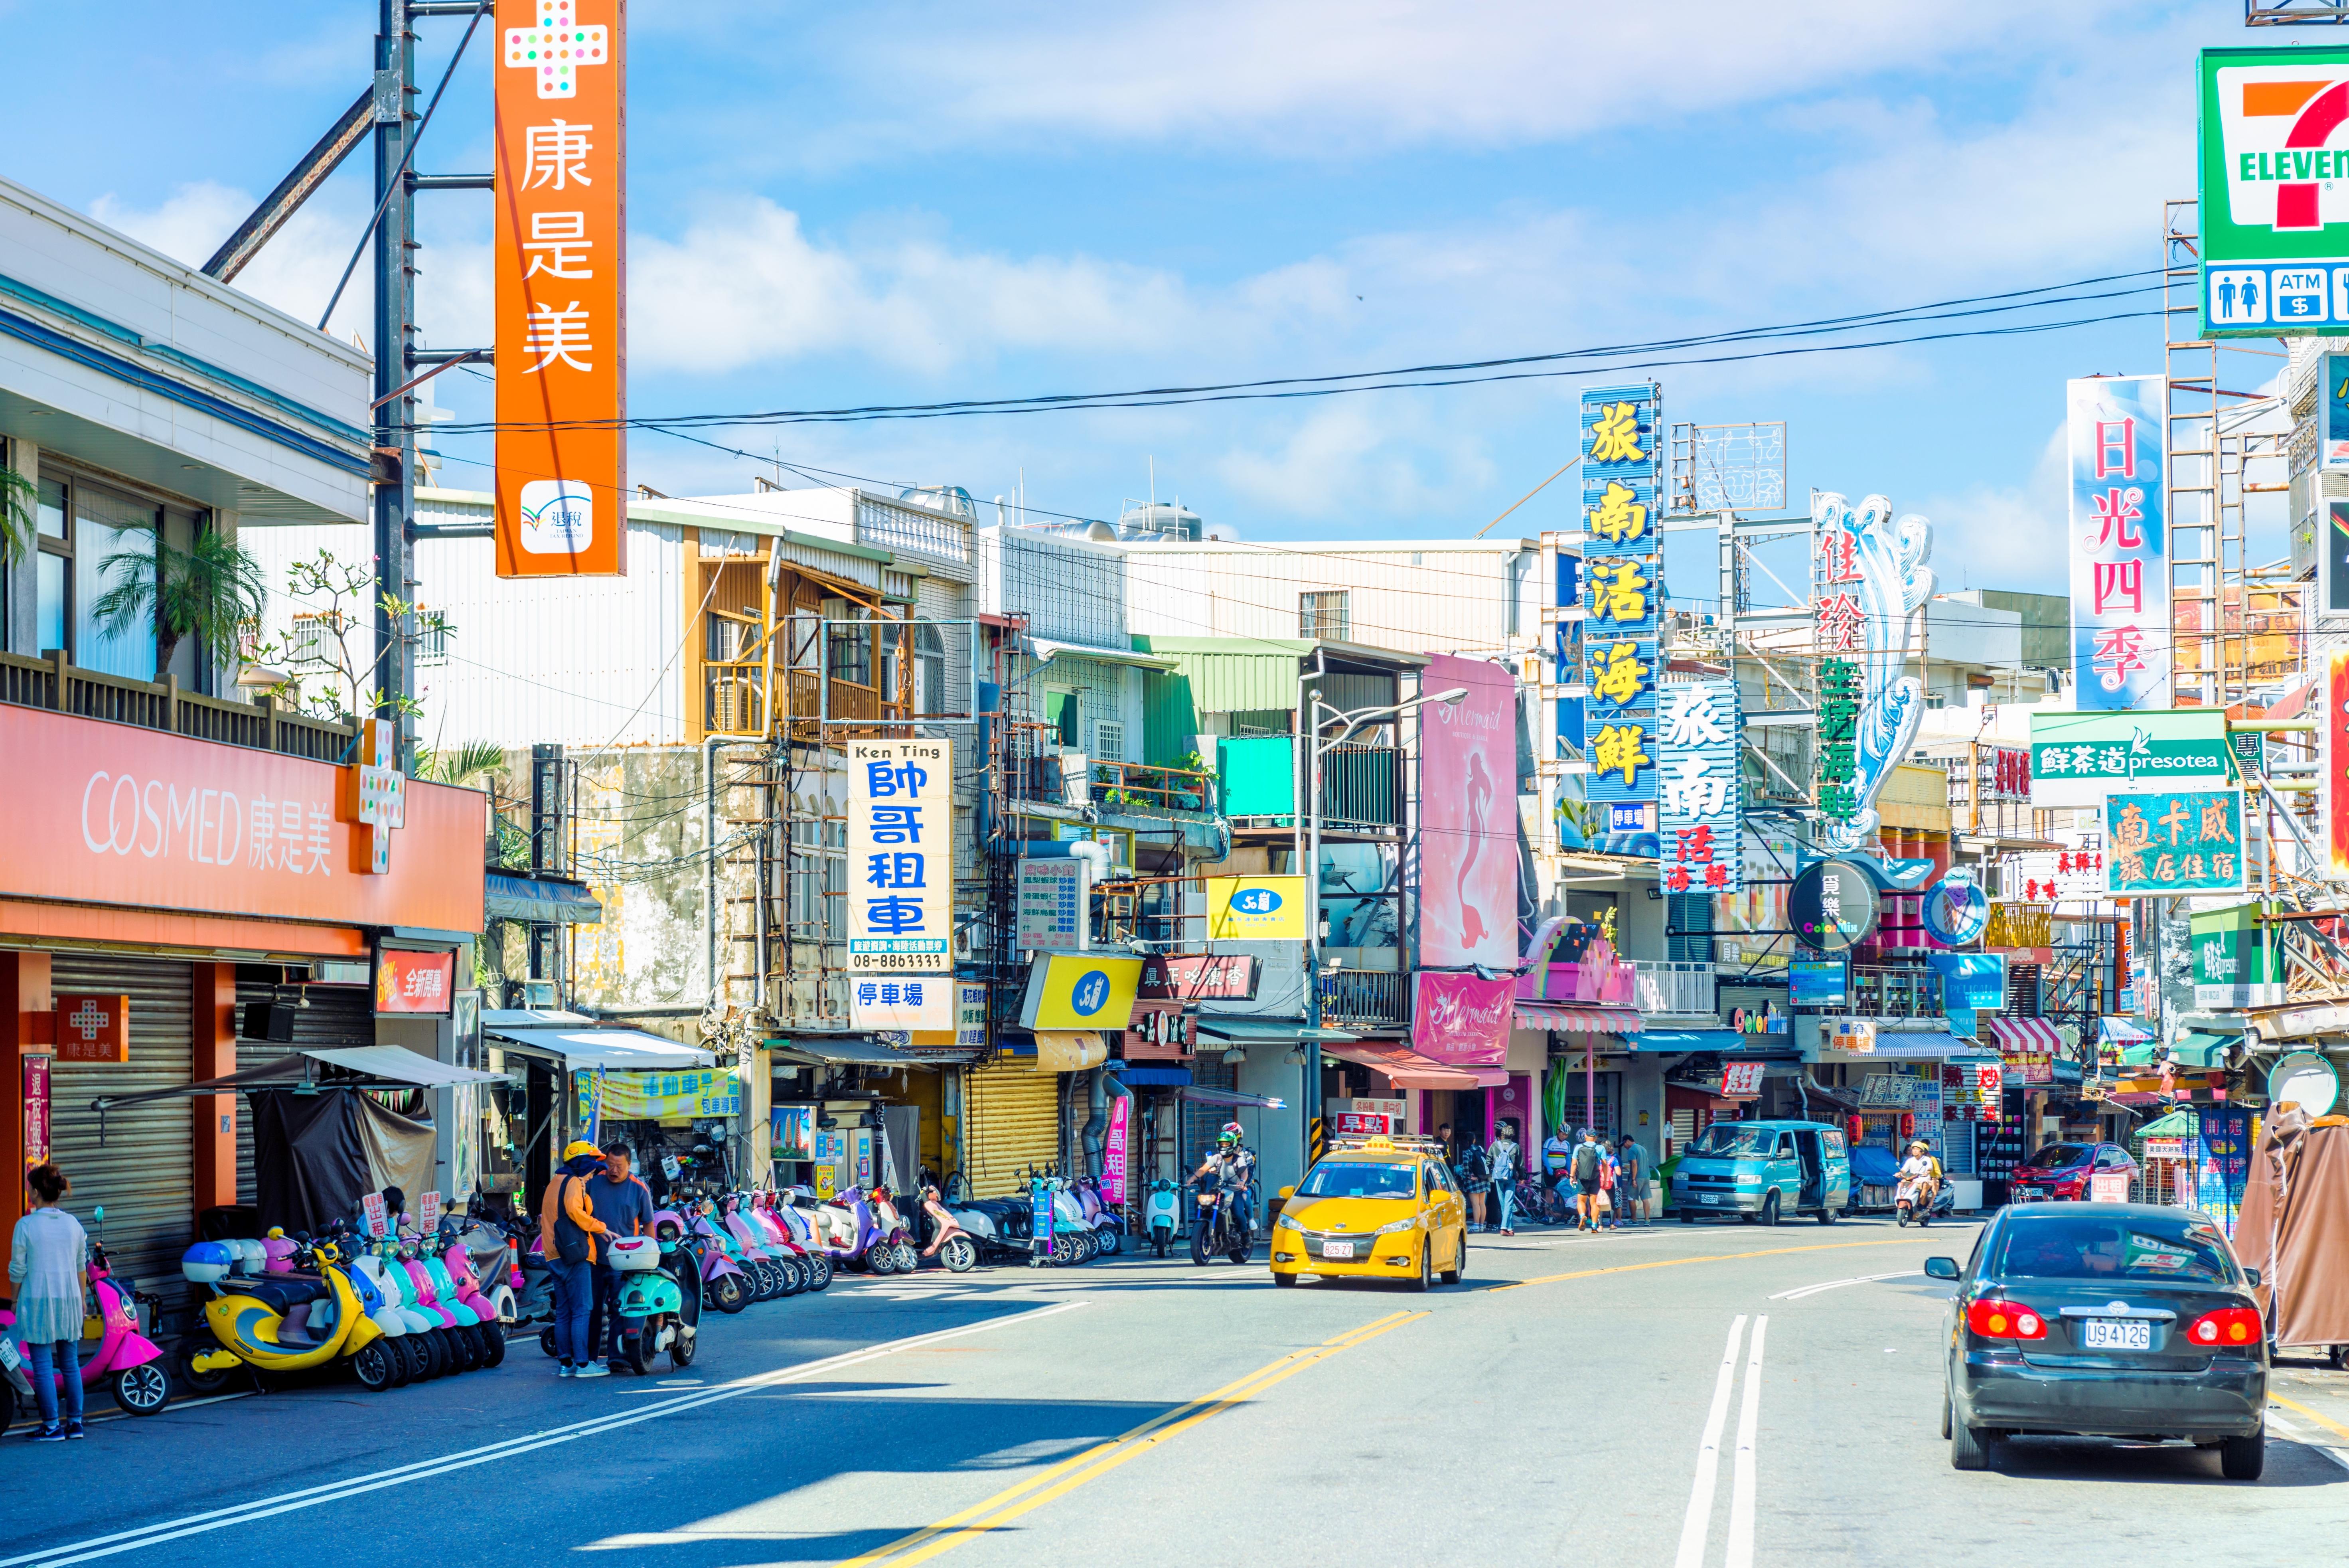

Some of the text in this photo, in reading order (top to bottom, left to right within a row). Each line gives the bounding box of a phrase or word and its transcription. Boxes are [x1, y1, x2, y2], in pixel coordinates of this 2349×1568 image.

[2240, 150, 2349, 181] ELEVEn
[520, 118, 593, 374] 康是美
[2280, 274, 2321, 289] ATM
[551, 511, 582, 527] 退稅
[2083, 417, 2156, 691] 日光四季
[1590, 400, 1650, 786] 旅南活海鮮
[1818, 531, 1867, 652] 佳珍
[1820, 657, 1859, 825] 生猛海鮮
[855, 745, 941, 759] Ken Ting
[2040, 745, 2219, 781] 鮮茶道 presotea
[82, 770, 332, 877] COSMED 康是美
[1614, 809, 1643, 826] 停車場
[2116, 799, 2236, 847] 南卡威
[867, 760, 928, 935] 帥哥租車
[1024, 864, 1076, 876] 南味小館
[2118, 851, 2236, 883] 旅店住宿
[1242, 891, 1271, 911] 50嵐
[1822, 875, 1840, 917] 覓樂
[1804, 919, 1858, 933] ColorMix
[854, 954, 941, 968] 08-8863333
[1723, 942, 1739, 963] 覓樂
[377, 960, 396, 986] NEW
[403, 968, 442, 998] 全新開幕
[857, 982, 923, 1007] 停車場
[1839, 1023, 1864, 1034] 備有
[67, 1043, 113, 1057] 康是美
[1832, 1036, 1870, 1050] 停車場
[643, 1074, 699, 1096] 電動車
[701, 1096, 740, 1115] 包車導覽
[1342, 1116, 1384, 1133] 早點
[2096, 1179, 2123, 1192] 出租
[363, 1193, 383, 1208] 電動車
[421, 1193, 440, 1205] 電動車
[369, 1206, 385, 1236] 出租
[423, 1204, 436, 1232] 出租
[1325, 1245, 1352, 1255] 825-Z7
